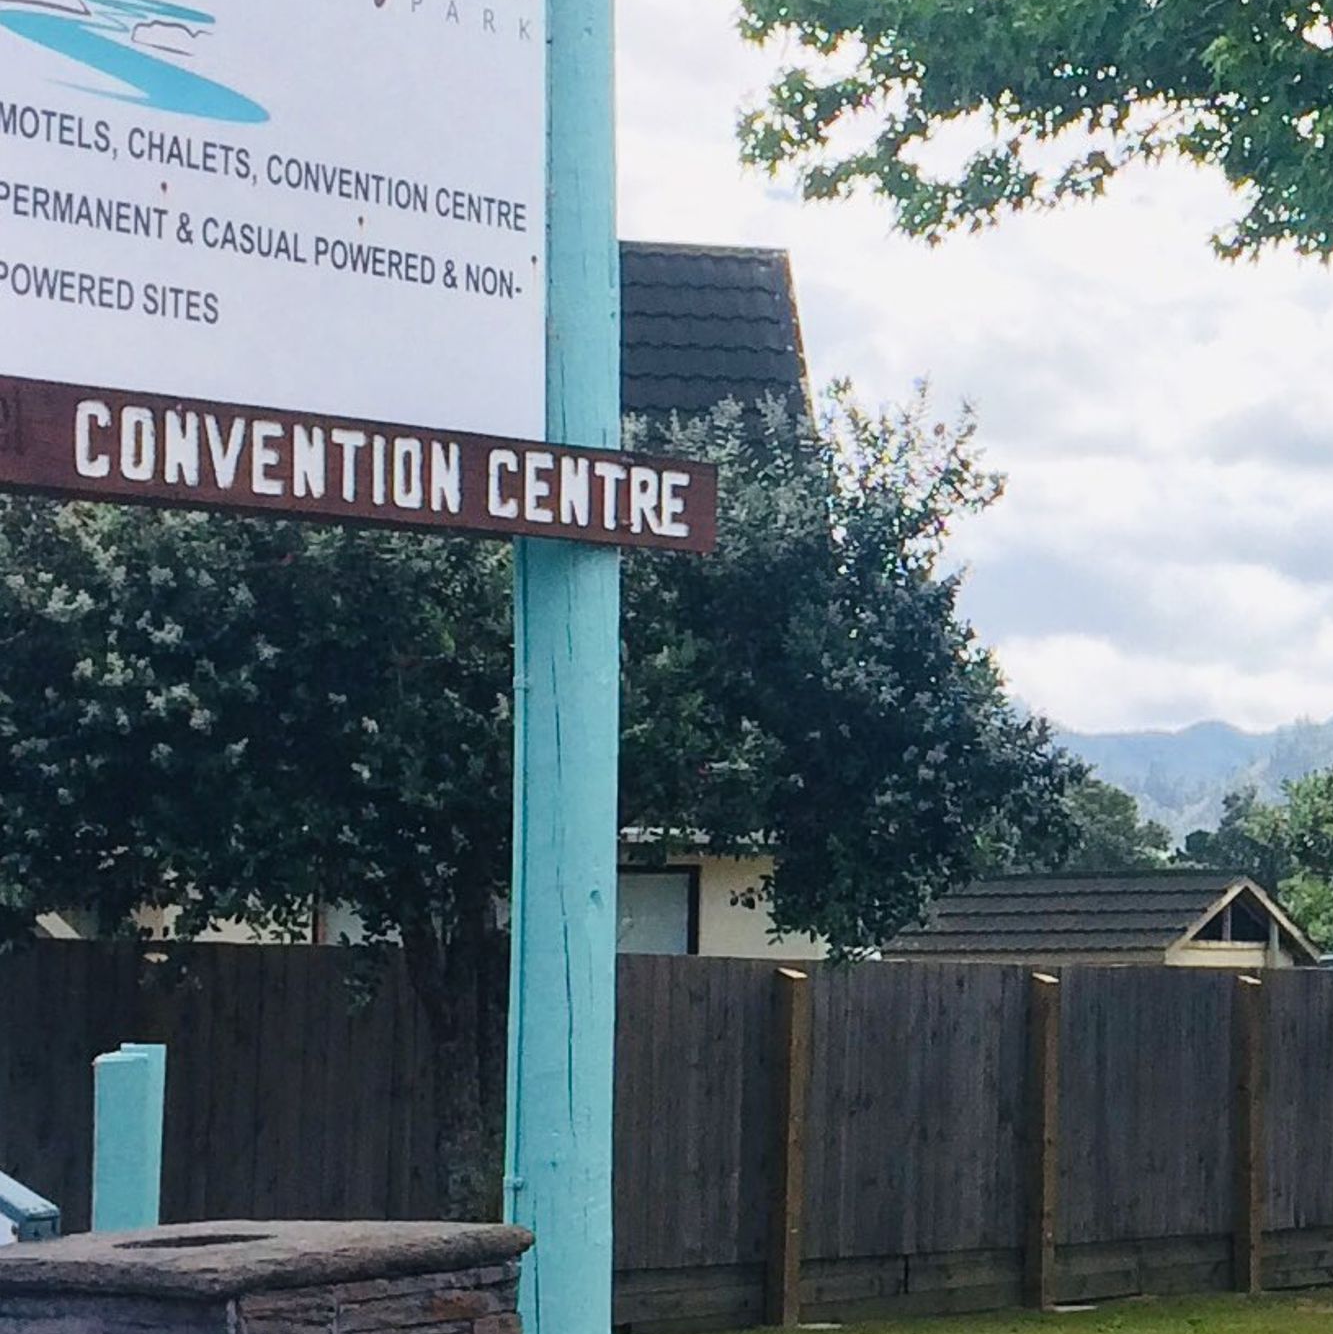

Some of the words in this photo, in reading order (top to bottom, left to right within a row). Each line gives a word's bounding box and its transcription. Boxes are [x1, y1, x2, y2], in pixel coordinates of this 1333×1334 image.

[0, 100, 118, 161] MOTELS,
[128, 127, 258, 187] CHALETS,
[267, 154, 428, 213] CONVENTION
[435, 187, 527, 232] CENTRE
[143, 283, 220, 325] SITES
[176, 212, 194, 245] &
[202, 217, 307, 263] CASUAL
[314, 236, 436, 285] POWERED
[443, 259, 458, 289] &
[465, 263, 523, 299] NON-
[75, 399, 463, 515] CONVENTION
[487, 448, 690, 537] CENTRE
